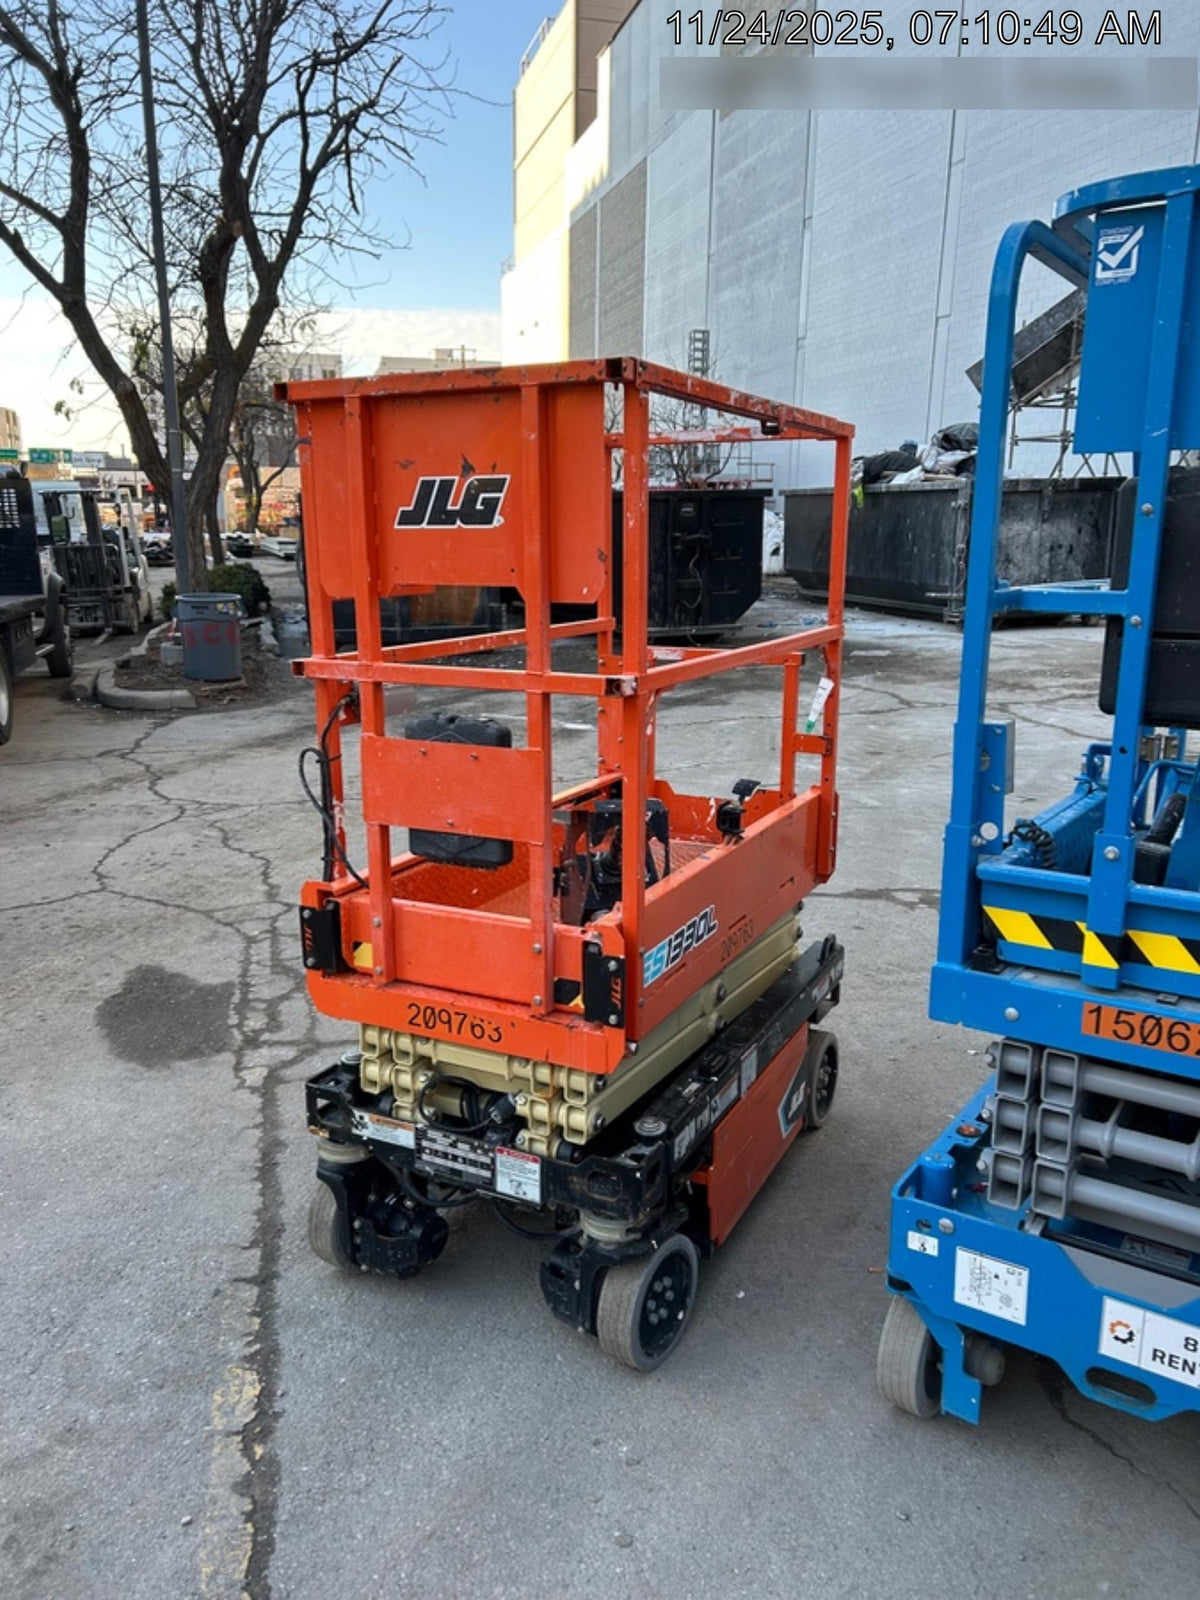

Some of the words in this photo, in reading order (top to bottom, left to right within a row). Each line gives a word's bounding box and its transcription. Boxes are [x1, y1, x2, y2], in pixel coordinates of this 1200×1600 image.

[395, 475, 511, 528] JLG
[407, 1002, 502, 1043] 209763
[1088, 1005, 1200, 1056] 1506
[1151, 1347, 1200, 1375] REN
